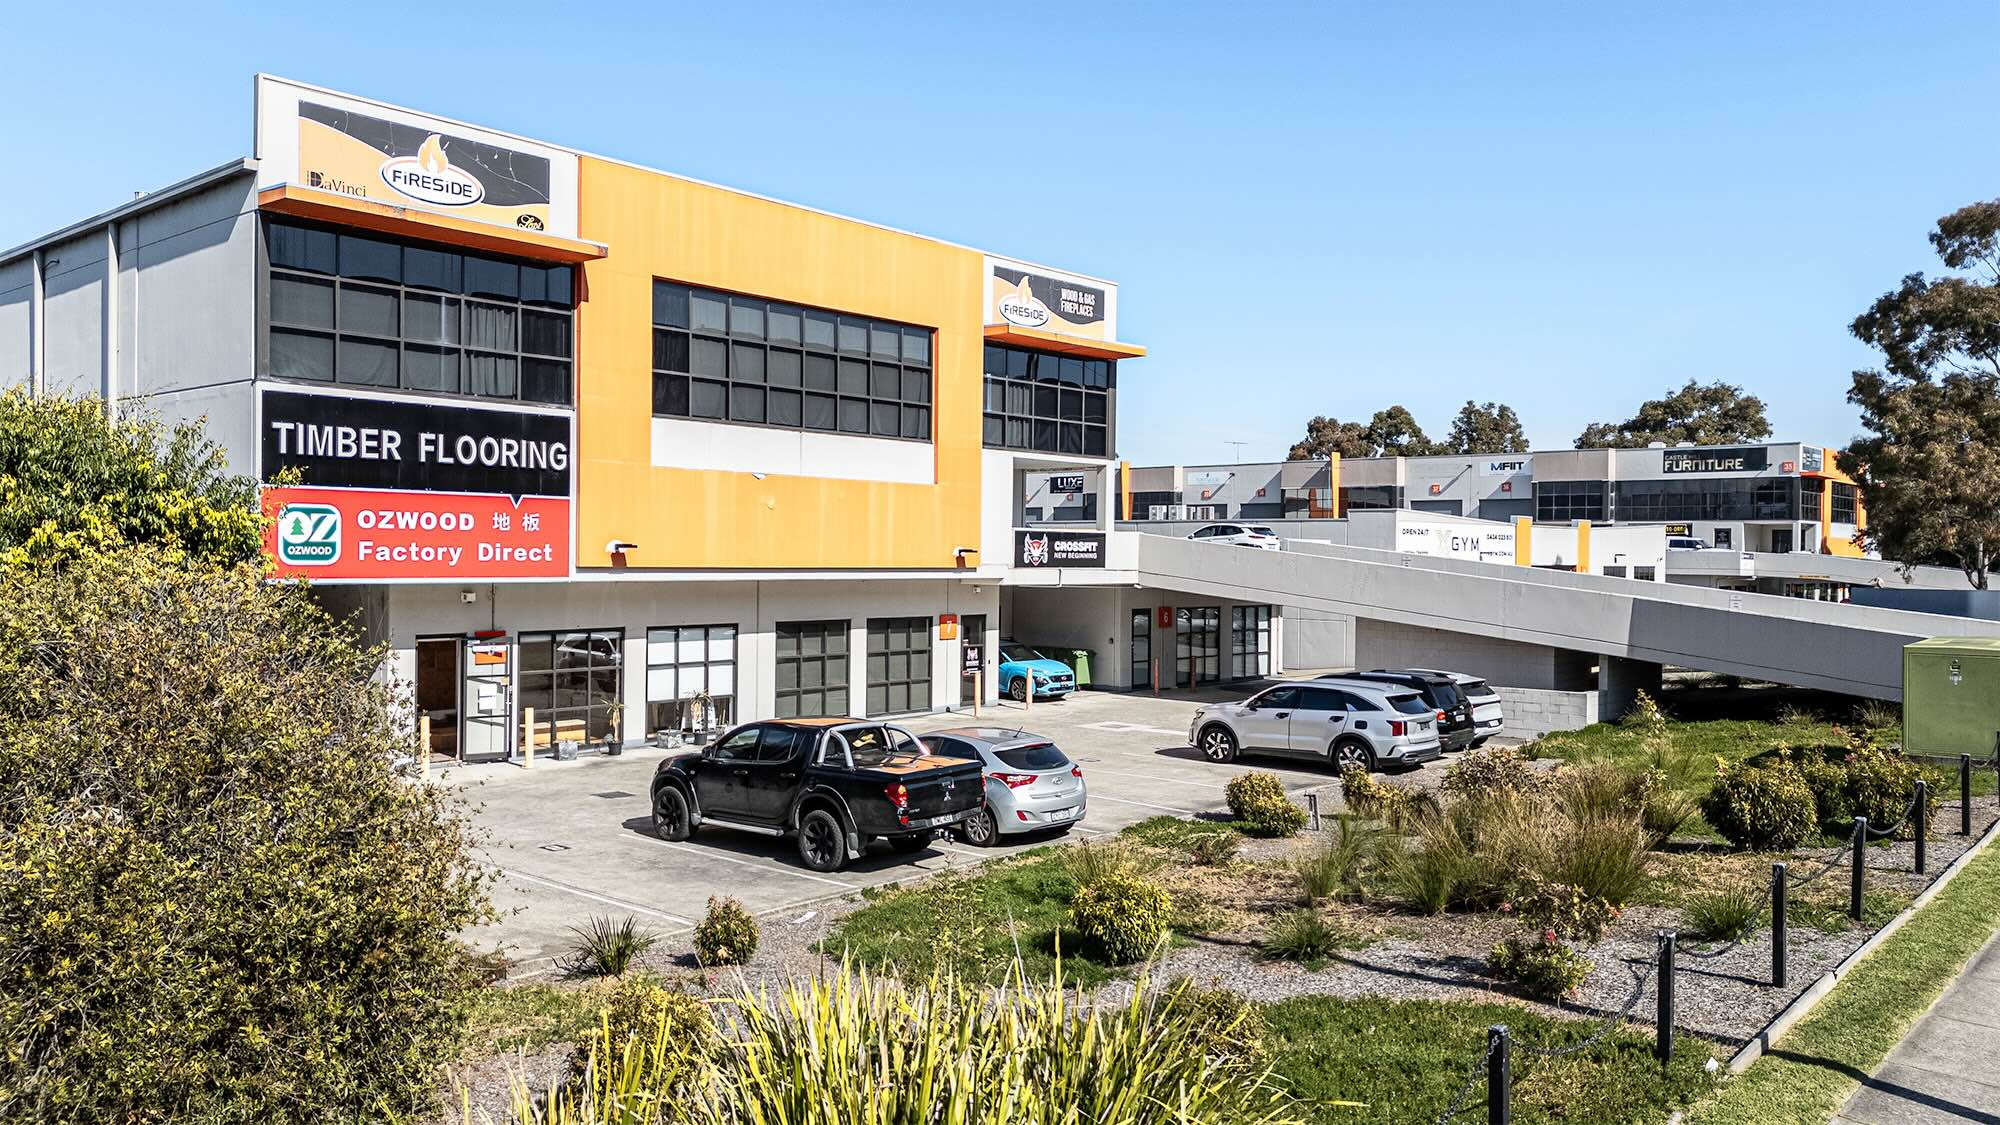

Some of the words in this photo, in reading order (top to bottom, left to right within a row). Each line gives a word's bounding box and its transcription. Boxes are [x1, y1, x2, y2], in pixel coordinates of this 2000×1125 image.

[1060, 288, 1078, 302] WOOD
[1084, 292, 1096, 306] GAS
[1060, 300, 1094, 318] FIREPLACES
[271, 421, 402, 461] TIMBER
[418, 431, 568, 471] FLOORING
[1664, 458, 1744, 472] FURNITURE
[1057, 477, 1083, 490] LUXE
[357, 510, 475, 531] OZWOOD
[492, 512, 540, 533] 地板
[1402, 528, 1417, 536] OPEN
[287, 545, 333, 556] OZWOOD
[1053, 540, 1099, 552] CROSSFIT
[1451, 536, 1480, 552] GYM
[358, 541, 463, 566] Factory
[478, 543, 553, 562] Direct
[1067, 552, 1098, 560] BEGINNING
